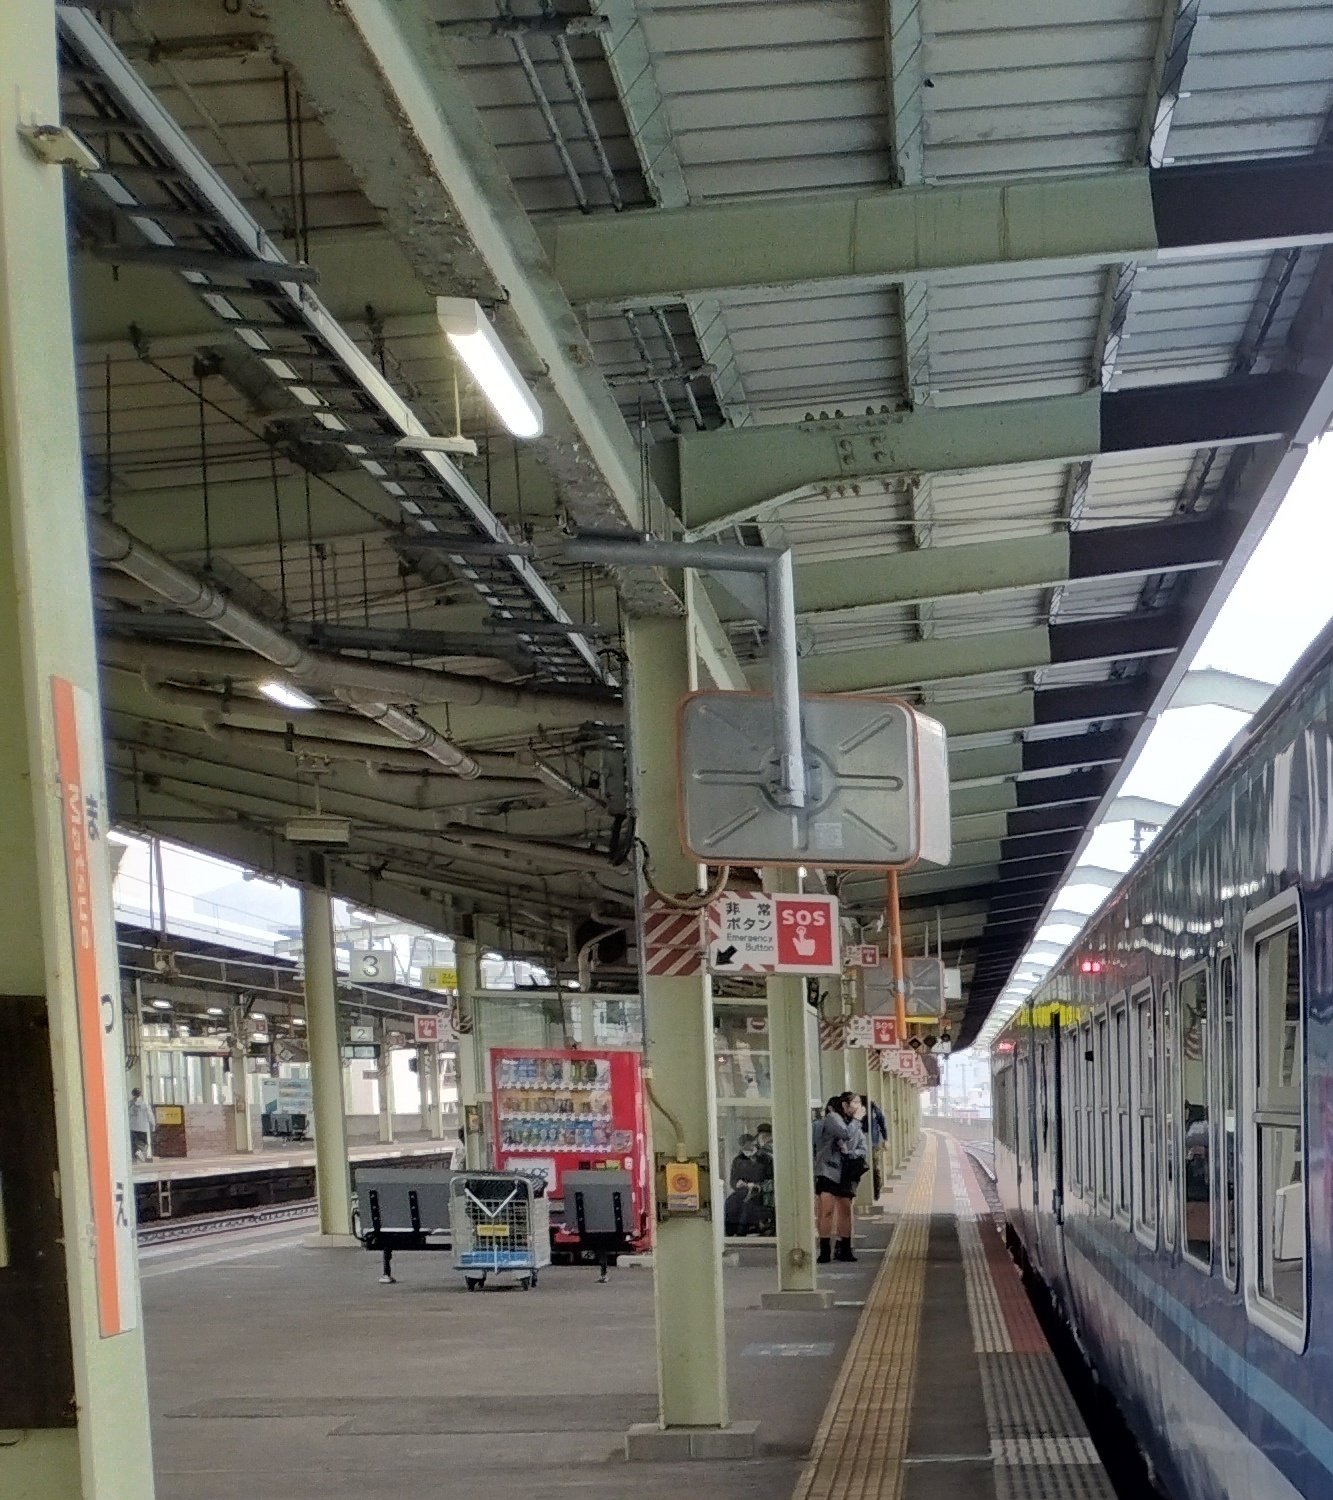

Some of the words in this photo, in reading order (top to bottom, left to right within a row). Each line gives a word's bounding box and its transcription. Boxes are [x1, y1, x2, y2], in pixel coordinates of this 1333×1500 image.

[725, 901, 771, 916] 非常
[726, 917, 772, 931] ボタン
[781, 909, 826, 926] SOS
[726, 933, 773, 943] Emergency
[745, 943, 774, 952] Button
[362, 955, 379, 977] 3
[86, 793, 129, 1228] まつえ
[356, 1028, 367, 1039] 2
